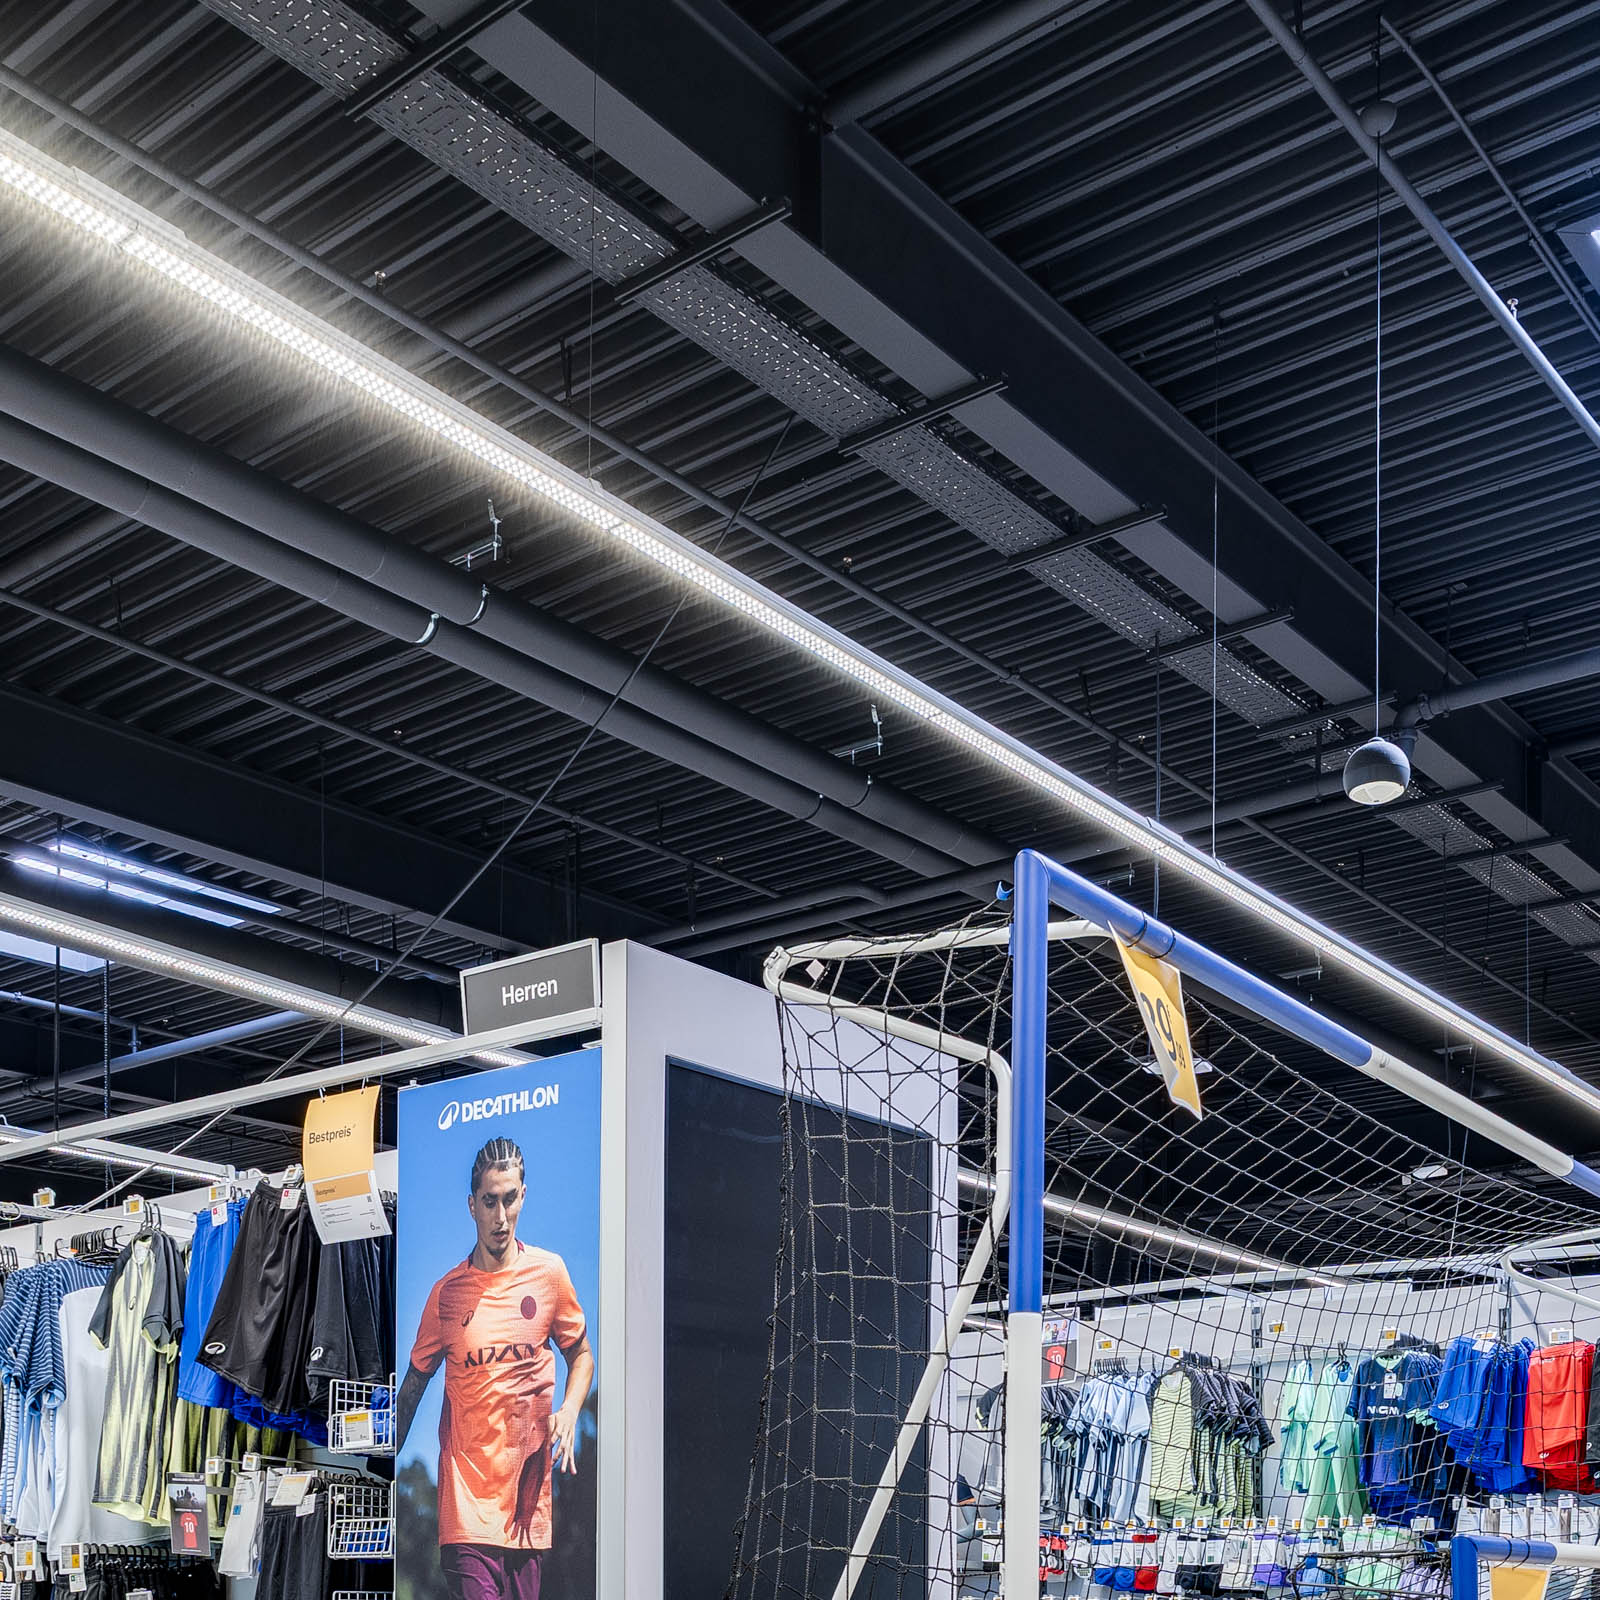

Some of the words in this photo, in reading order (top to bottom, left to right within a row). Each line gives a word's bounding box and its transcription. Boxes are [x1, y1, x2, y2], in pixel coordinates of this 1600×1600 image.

[502, 979, 558, 1006] Herren
[461, 1084, 559, 1123] DECATHLON
[309, 1125, 351, 1144] Bestpreis
[184, 1522, 195, 1533] 10
